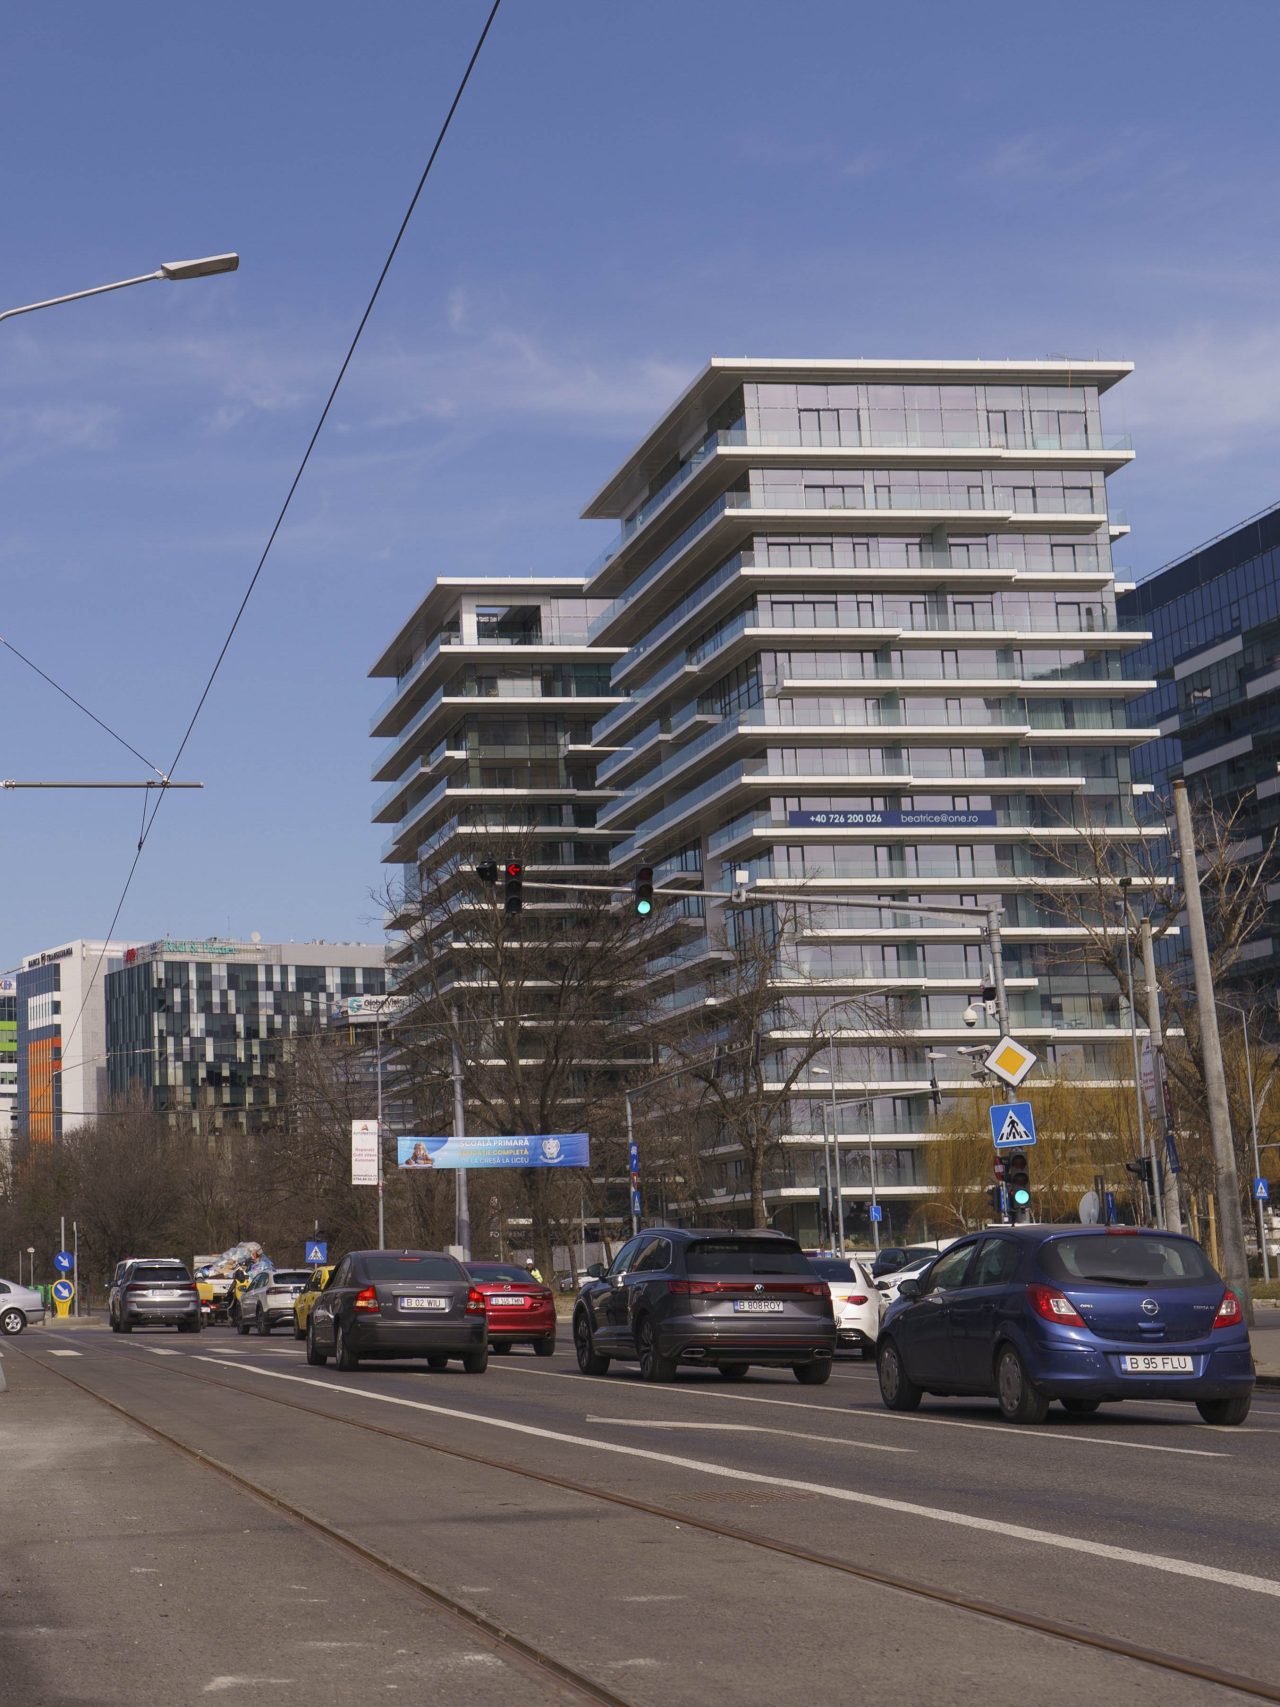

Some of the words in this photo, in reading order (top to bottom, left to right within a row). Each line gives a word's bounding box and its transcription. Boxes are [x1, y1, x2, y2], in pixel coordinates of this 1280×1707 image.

[809, 814, 827, 823] +40
[829, 814, 845, 823] 726
[847, 814, 864, 823] 200
[866, 814, 882, 823] 026
[900, 813, 979, 823] beatrice@one.ro
[406, 1298, 413, 1307] B
[415, 1298, 425, 1307] 02
[739, 1301, 745, 1310] B
[1129, 1357, 1139, 1370] B
[1143, 1357, 1158, 1370] 95
[1162, 1357, 1187, 1370] FLU
